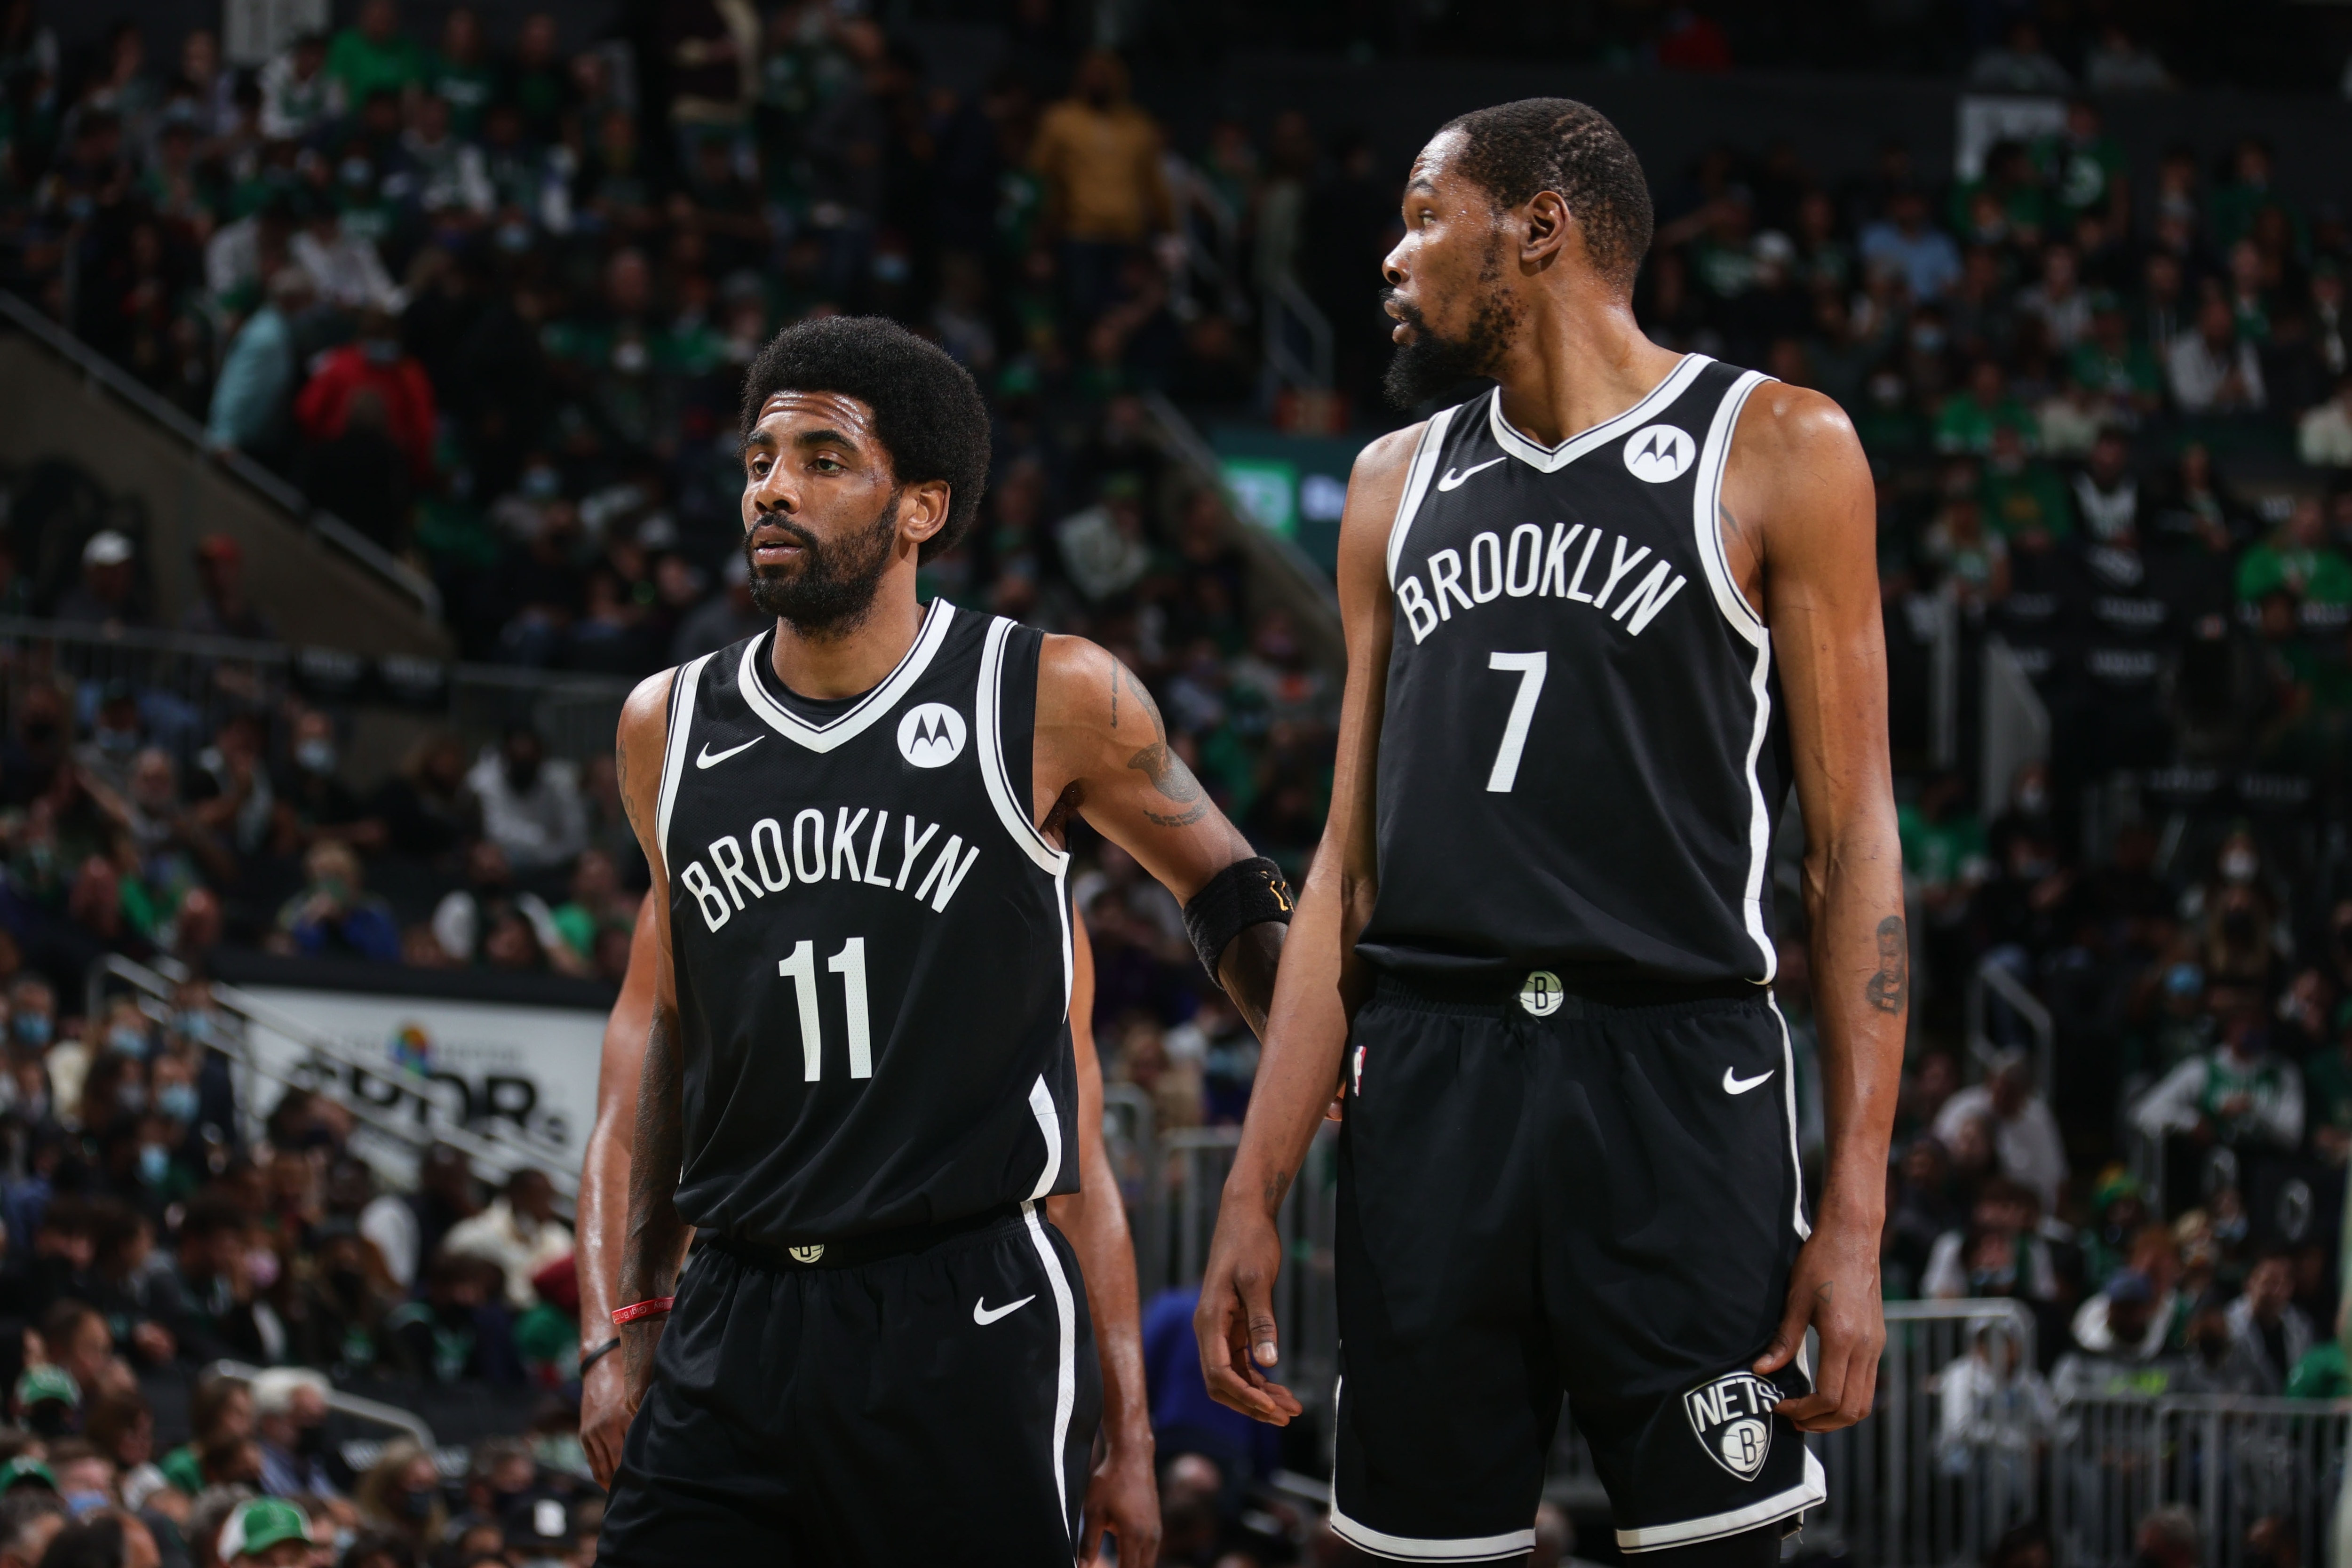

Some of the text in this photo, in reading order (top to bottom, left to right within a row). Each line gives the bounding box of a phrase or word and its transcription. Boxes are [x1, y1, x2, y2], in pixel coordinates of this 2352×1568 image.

[1397, 522, 1687, 645] BROOKLYN
[1486, 651, 1548, 793] 7
[681, 806, 980, 933] BROOKLYN
[779, 937, 873, 1082] 11
[1535, 977, 1548, 1010] B
[630, 1305, 647, 1318] Gigi
[1693, 1377, 1780, 1433] NETS
[1739, 1427, 1758, 1466] B
